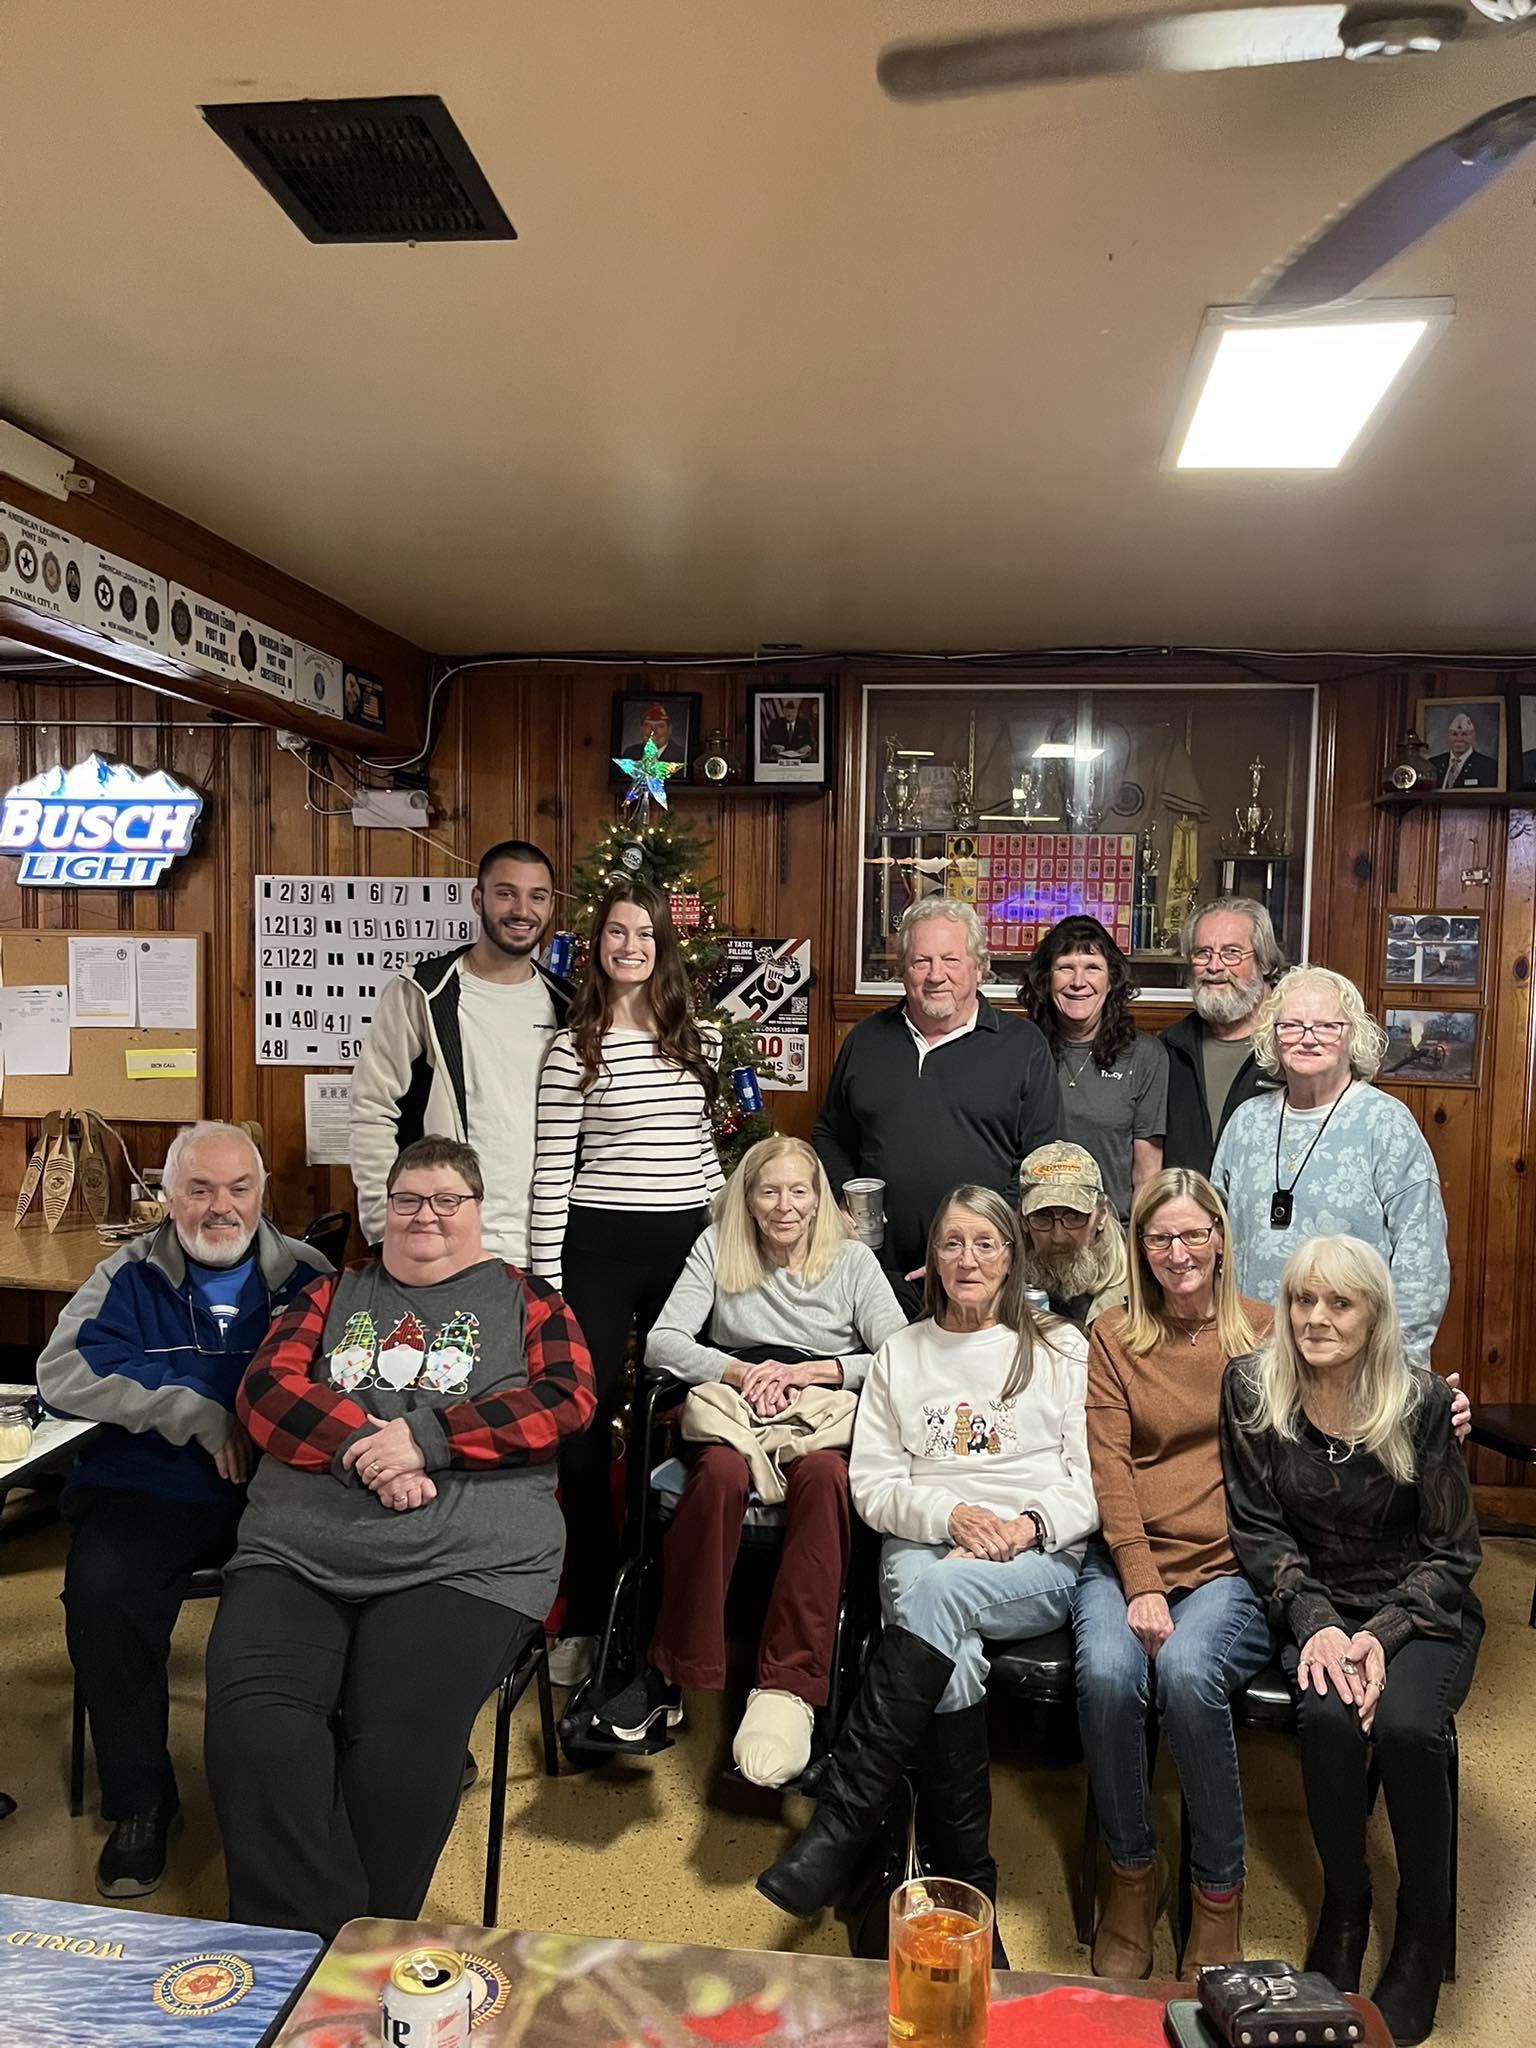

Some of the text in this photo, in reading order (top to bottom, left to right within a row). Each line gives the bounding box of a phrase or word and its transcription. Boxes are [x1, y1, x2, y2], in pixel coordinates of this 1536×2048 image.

[8, 511, 61, 540] AMERICAN LEGION
[21, 528, 36, 542] POST
[10, 586, 36, 604] PANAMA
[0, 800, 196, 849] BUSCH
[22, 856, 167, 880] LIGHT
[280, 884, 457, 903] 2 3 4 6 7 9
[264, 916, 468, 939] 12 13 15 16 17 18
[263, 949, 284, 966] 21
[291, 949, 313, 967] 22
[383, 951, 404, 969] 25
[292, 1010, 345, 1032] 40 41
[262, 1040, 362, 1057] 48 50
[6, 1930, 125, 1960] WORLD
[161, 1960, 245, 2010] AMERICAN LEGION
